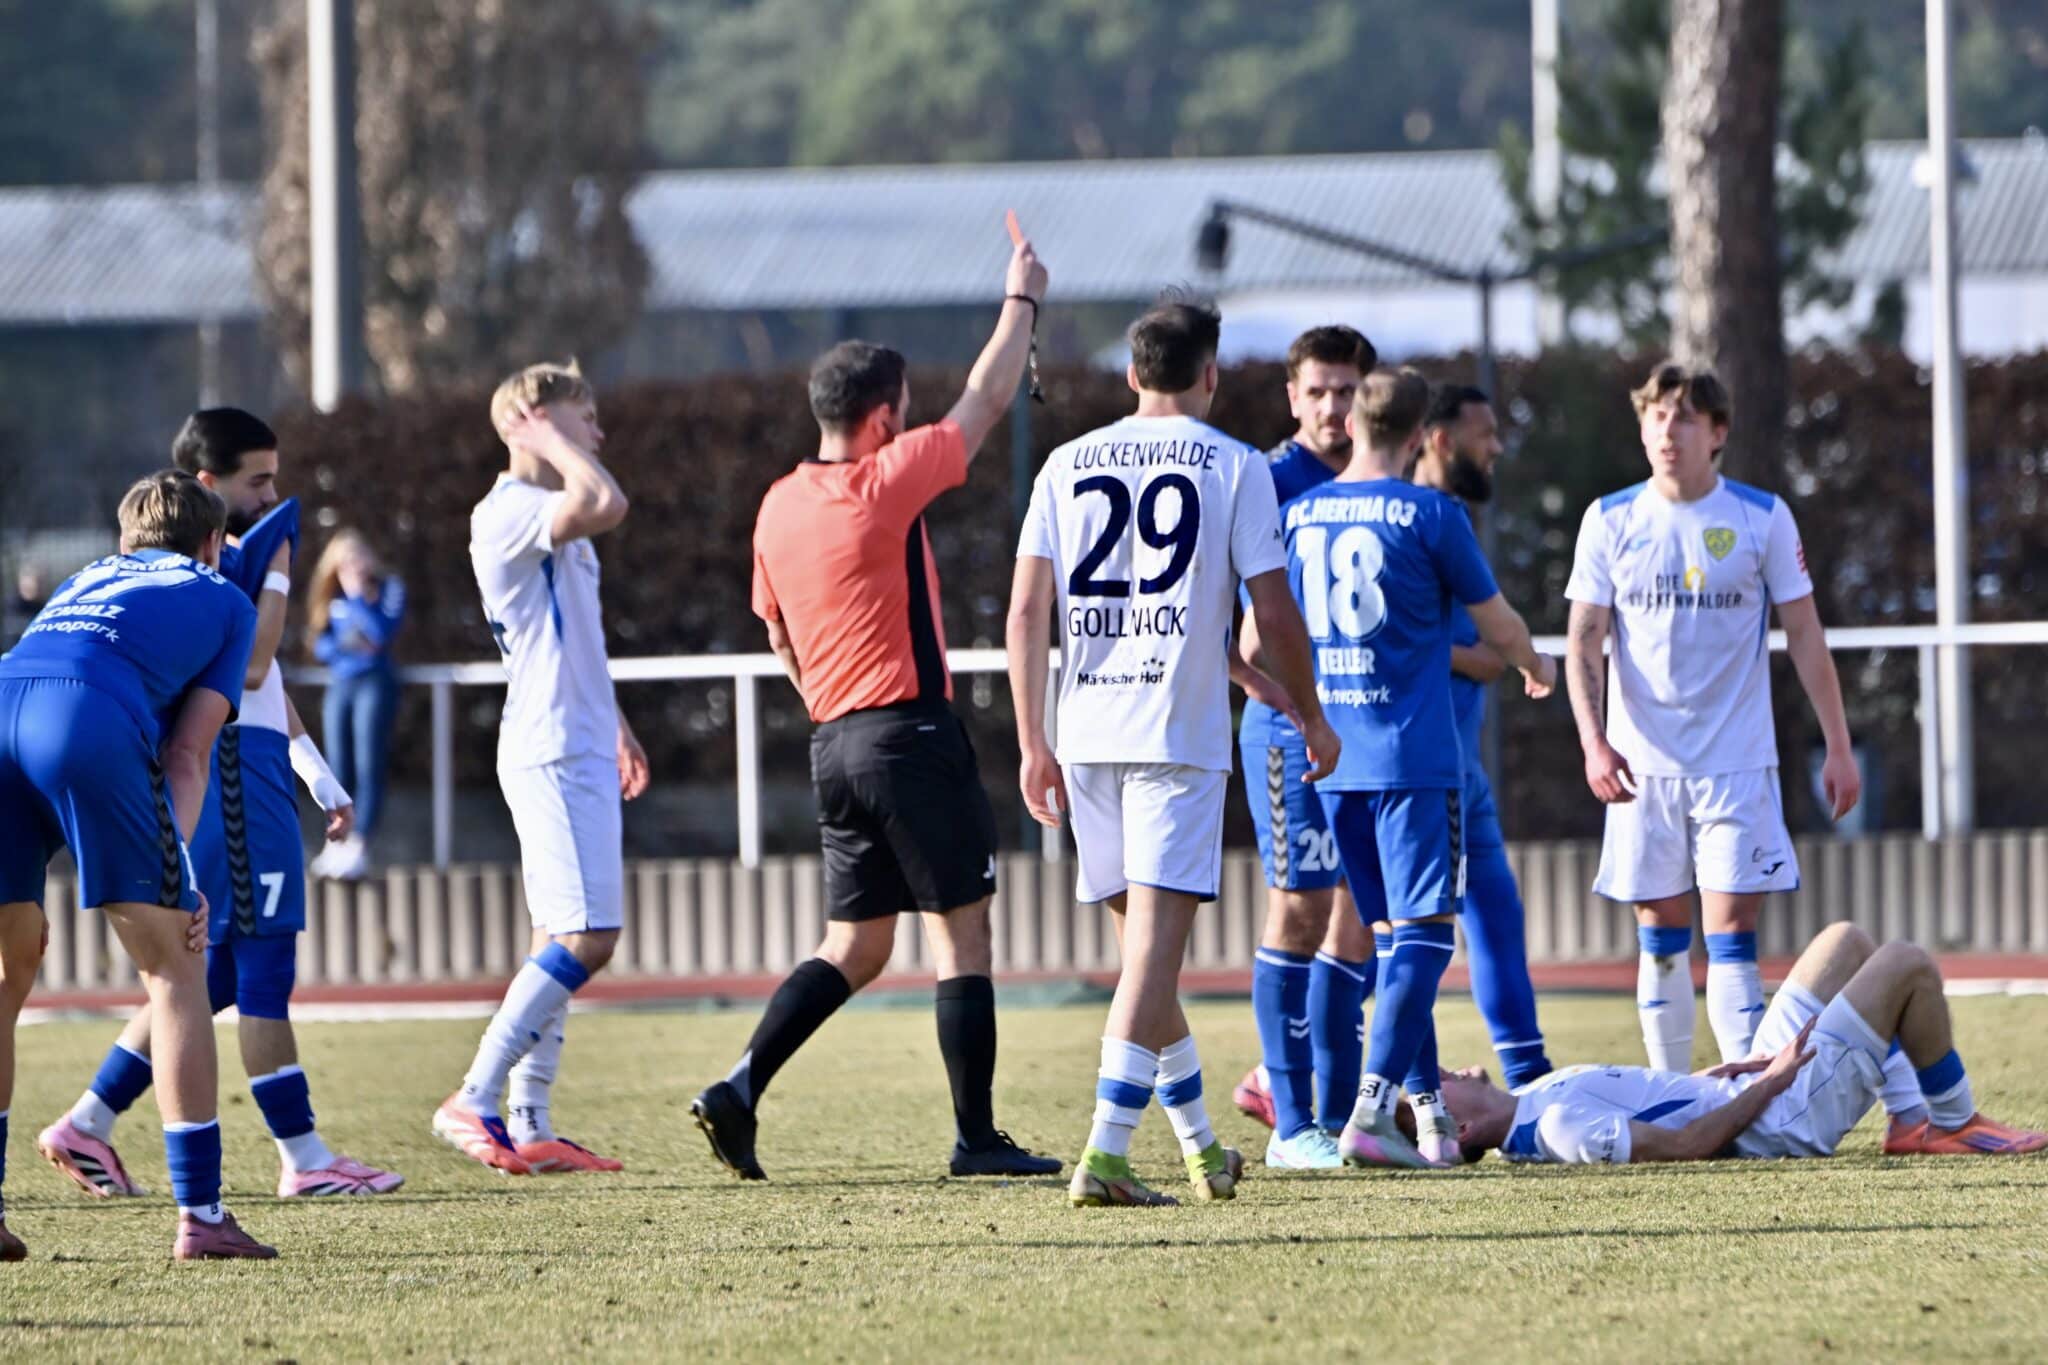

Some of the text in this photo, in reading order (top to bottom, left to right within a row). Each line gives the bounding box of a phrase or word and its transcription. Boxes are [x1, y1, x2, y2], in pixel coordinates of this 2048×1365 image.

[1074, 440, 1218, 470] LUCKENWALDE
[1069, 473, 1200, 597] 29
[1295, 525, 1388, 641] 18
[1655, 574, 1678, 591] DIE
[1140, 671, 1164, 684] Hof
[1297, 828, 1340, 871] 20
[259, 872, 285, 917] 7
